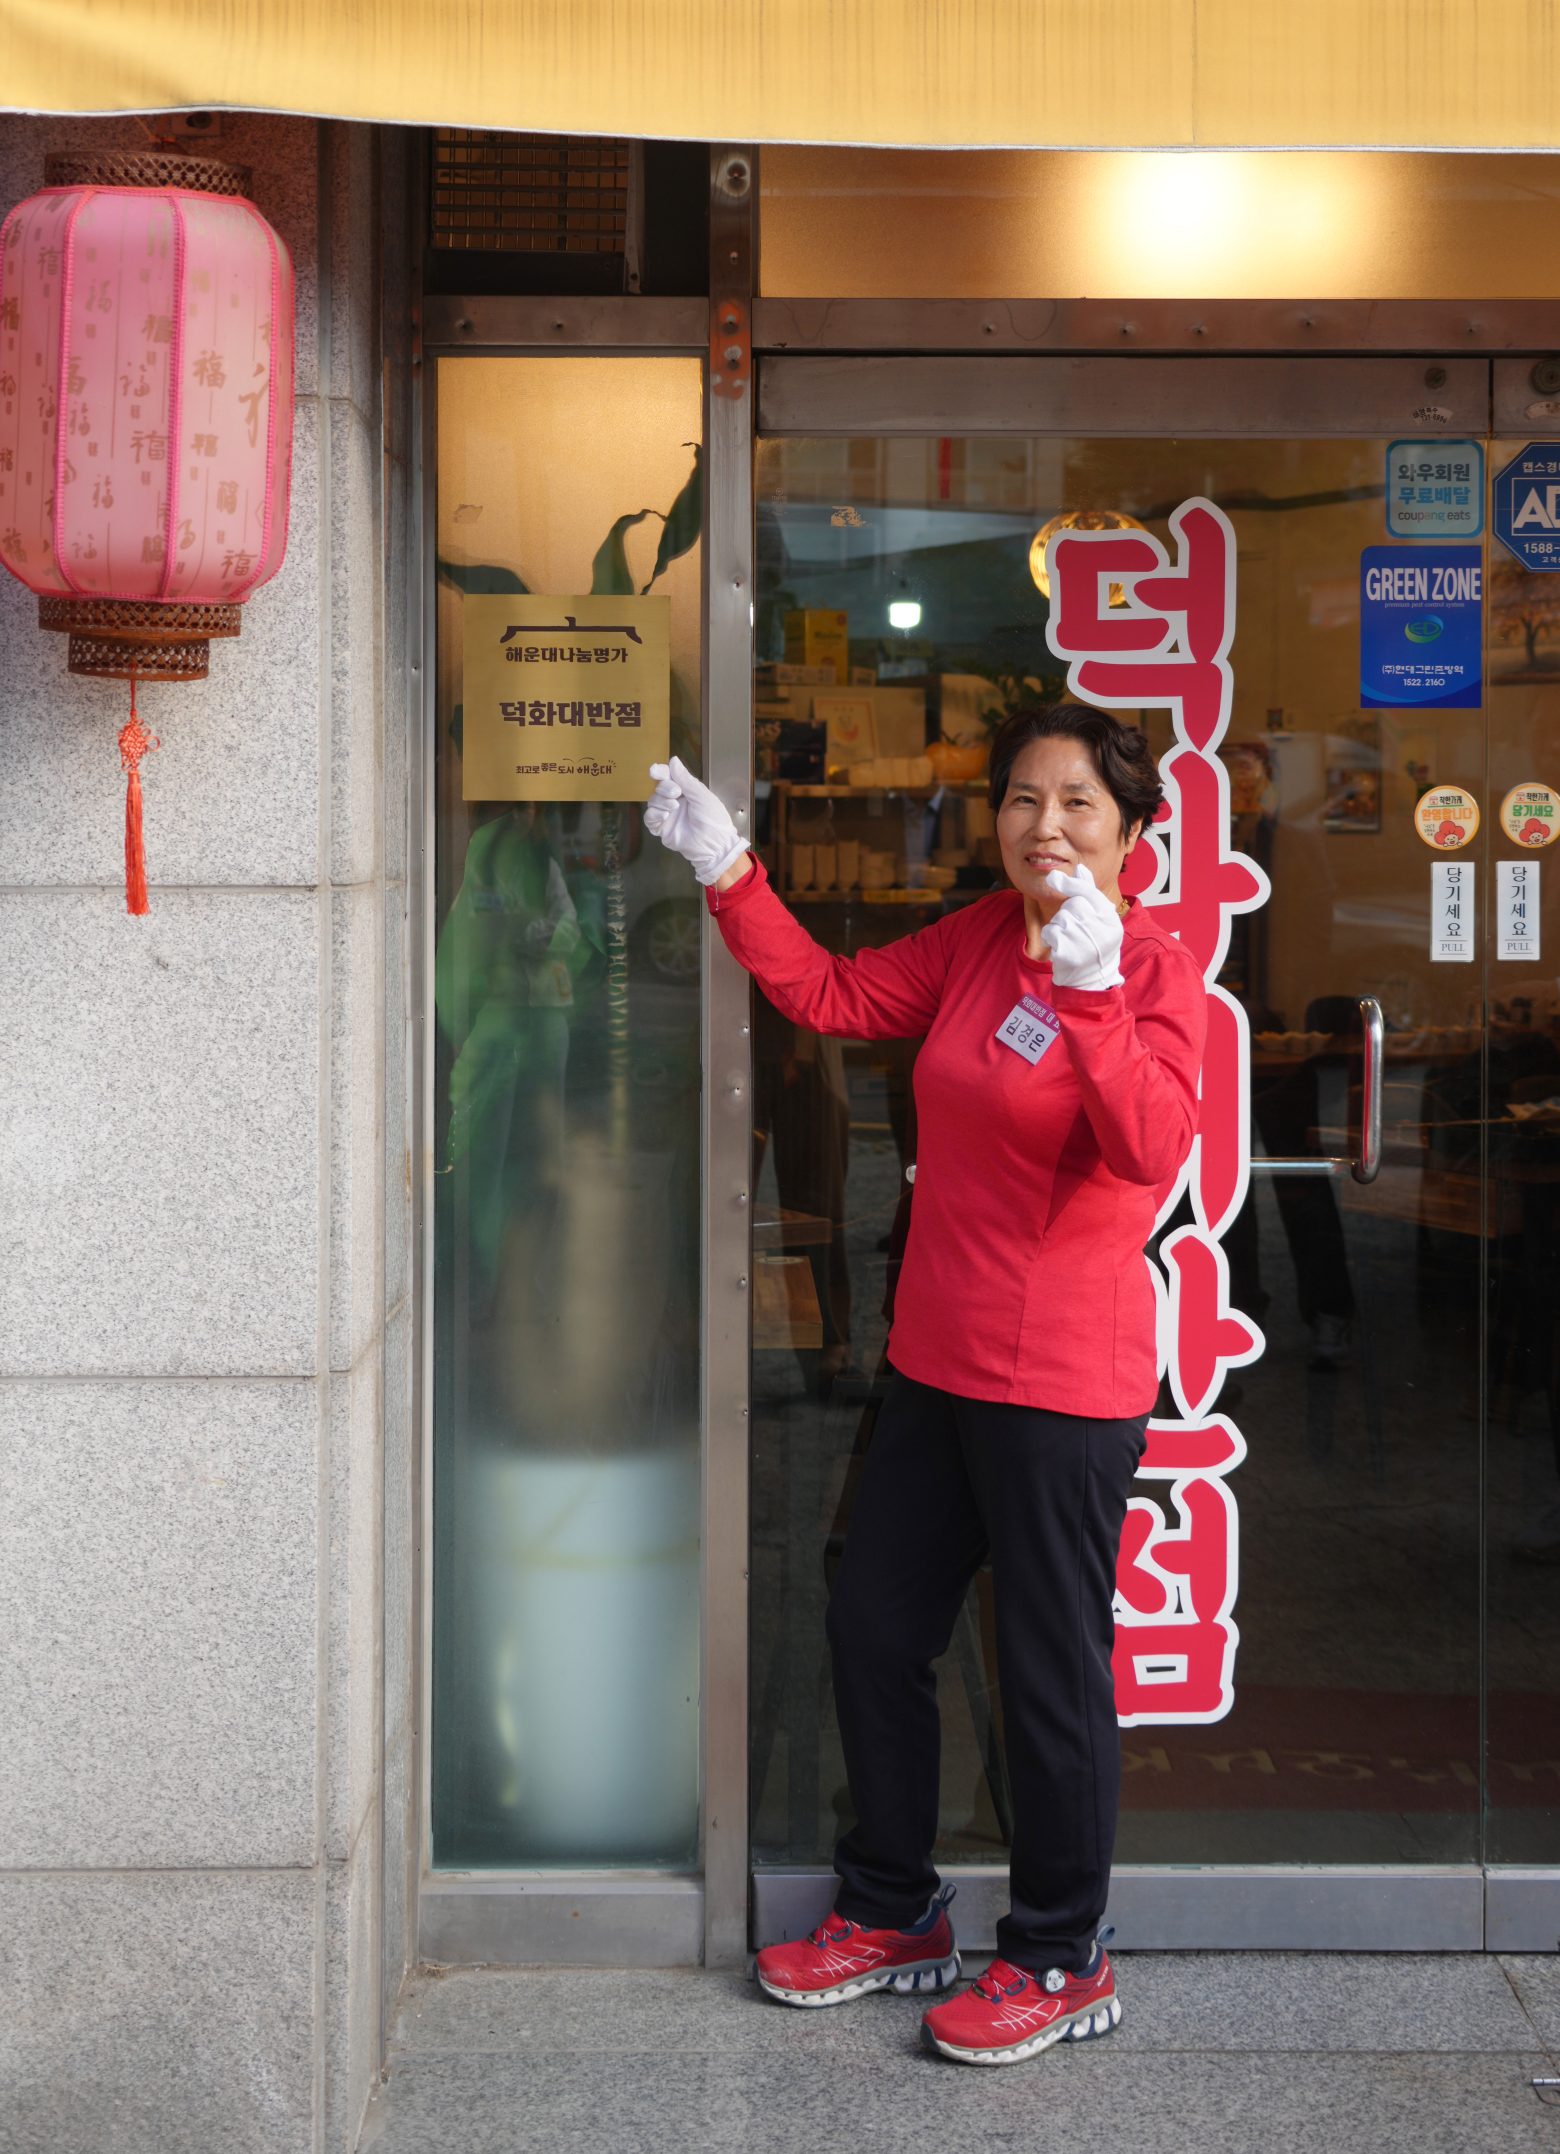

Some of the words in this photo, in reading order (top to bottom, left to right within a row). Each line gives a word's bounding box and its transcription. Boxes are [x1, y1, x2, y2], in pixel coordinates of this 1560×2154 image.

[193, 349, 226, 390] 福
[1398, 463, 1471, 482] 와우회원
[1398, 487, 1471, 505] 무료배달
[1398, 510, 1445, 522] coupang
[1447, 510, 1471, 521] eats
[221, 549, 258, 580] 福
[1366, 567, 1431, 601] GREEN
[1432, 567, 1482, 601] ZONE
[505, 646, 628, 663] 해운대나눔명가
[499, 700, 642, 728] 덕화대반점
[577, 762, 612, 777] 해운대
[1439, 795, 1463, 805] 착한가게
[1526, 792, 1550, 802] 착한가게
[1421, 807, 1473, 821] 환영합니다
[1512, 804, 1554, 818] 당기세요
[1444, 867, 1462, 937] 당기세요
[1510, 866, 1528, 936] 당기세요
[1441, 943, 1465, 952] PULL
[1507, 942, 1531, 951] PULL
[1005, 1015, 1046, 1053] 김경은
